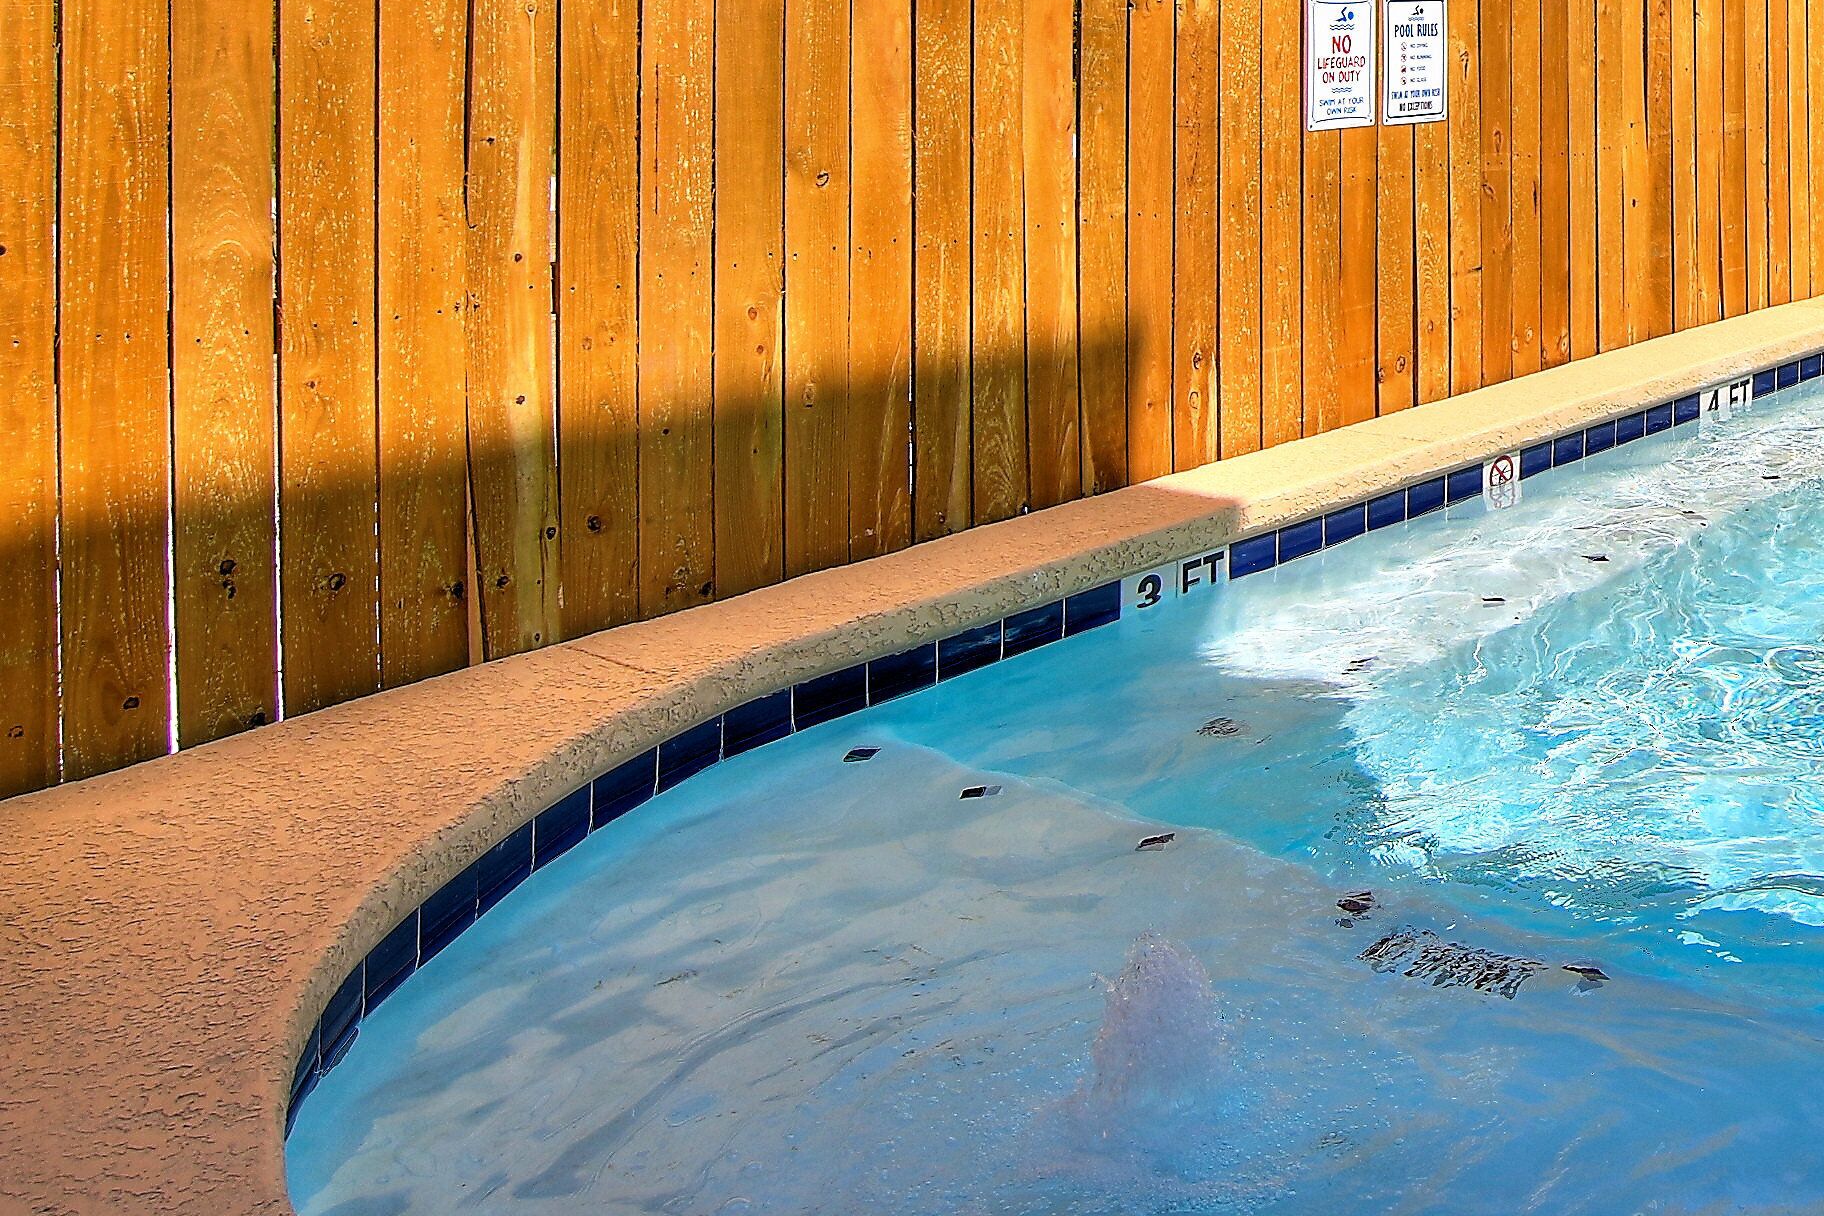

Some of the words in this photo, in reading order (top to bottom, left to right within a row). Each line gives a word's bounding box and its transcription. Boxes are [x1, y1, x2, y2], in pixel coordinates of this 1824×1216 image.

[1394, 23, 1414, 38] POOL
[1417, 23, 1438, 37] RULES
[1332, 35, 1351, 54] NO
[1317, 55, 1366, 70] LIFEGUARD
[1322, 71, 1335, 84] ON
[1338, 70, 1361, 83] DUTY
[1319, 98, 1336, 107] SWIM
[1337, 97, 1346, 105] AT
[1348, 96, 1364, 105] YOUR
[1399, 102, 1406, 112] NO
[1326, 107, 1342, 116] OWN
[1343, 106, 1358, 114] RISK
[1707, 389, 1719, 411] 4
[1730, 377, 1750, 406] FT
[1136, 573, 1162, 609] 3
[1182, 550, 1225, 594] FT
